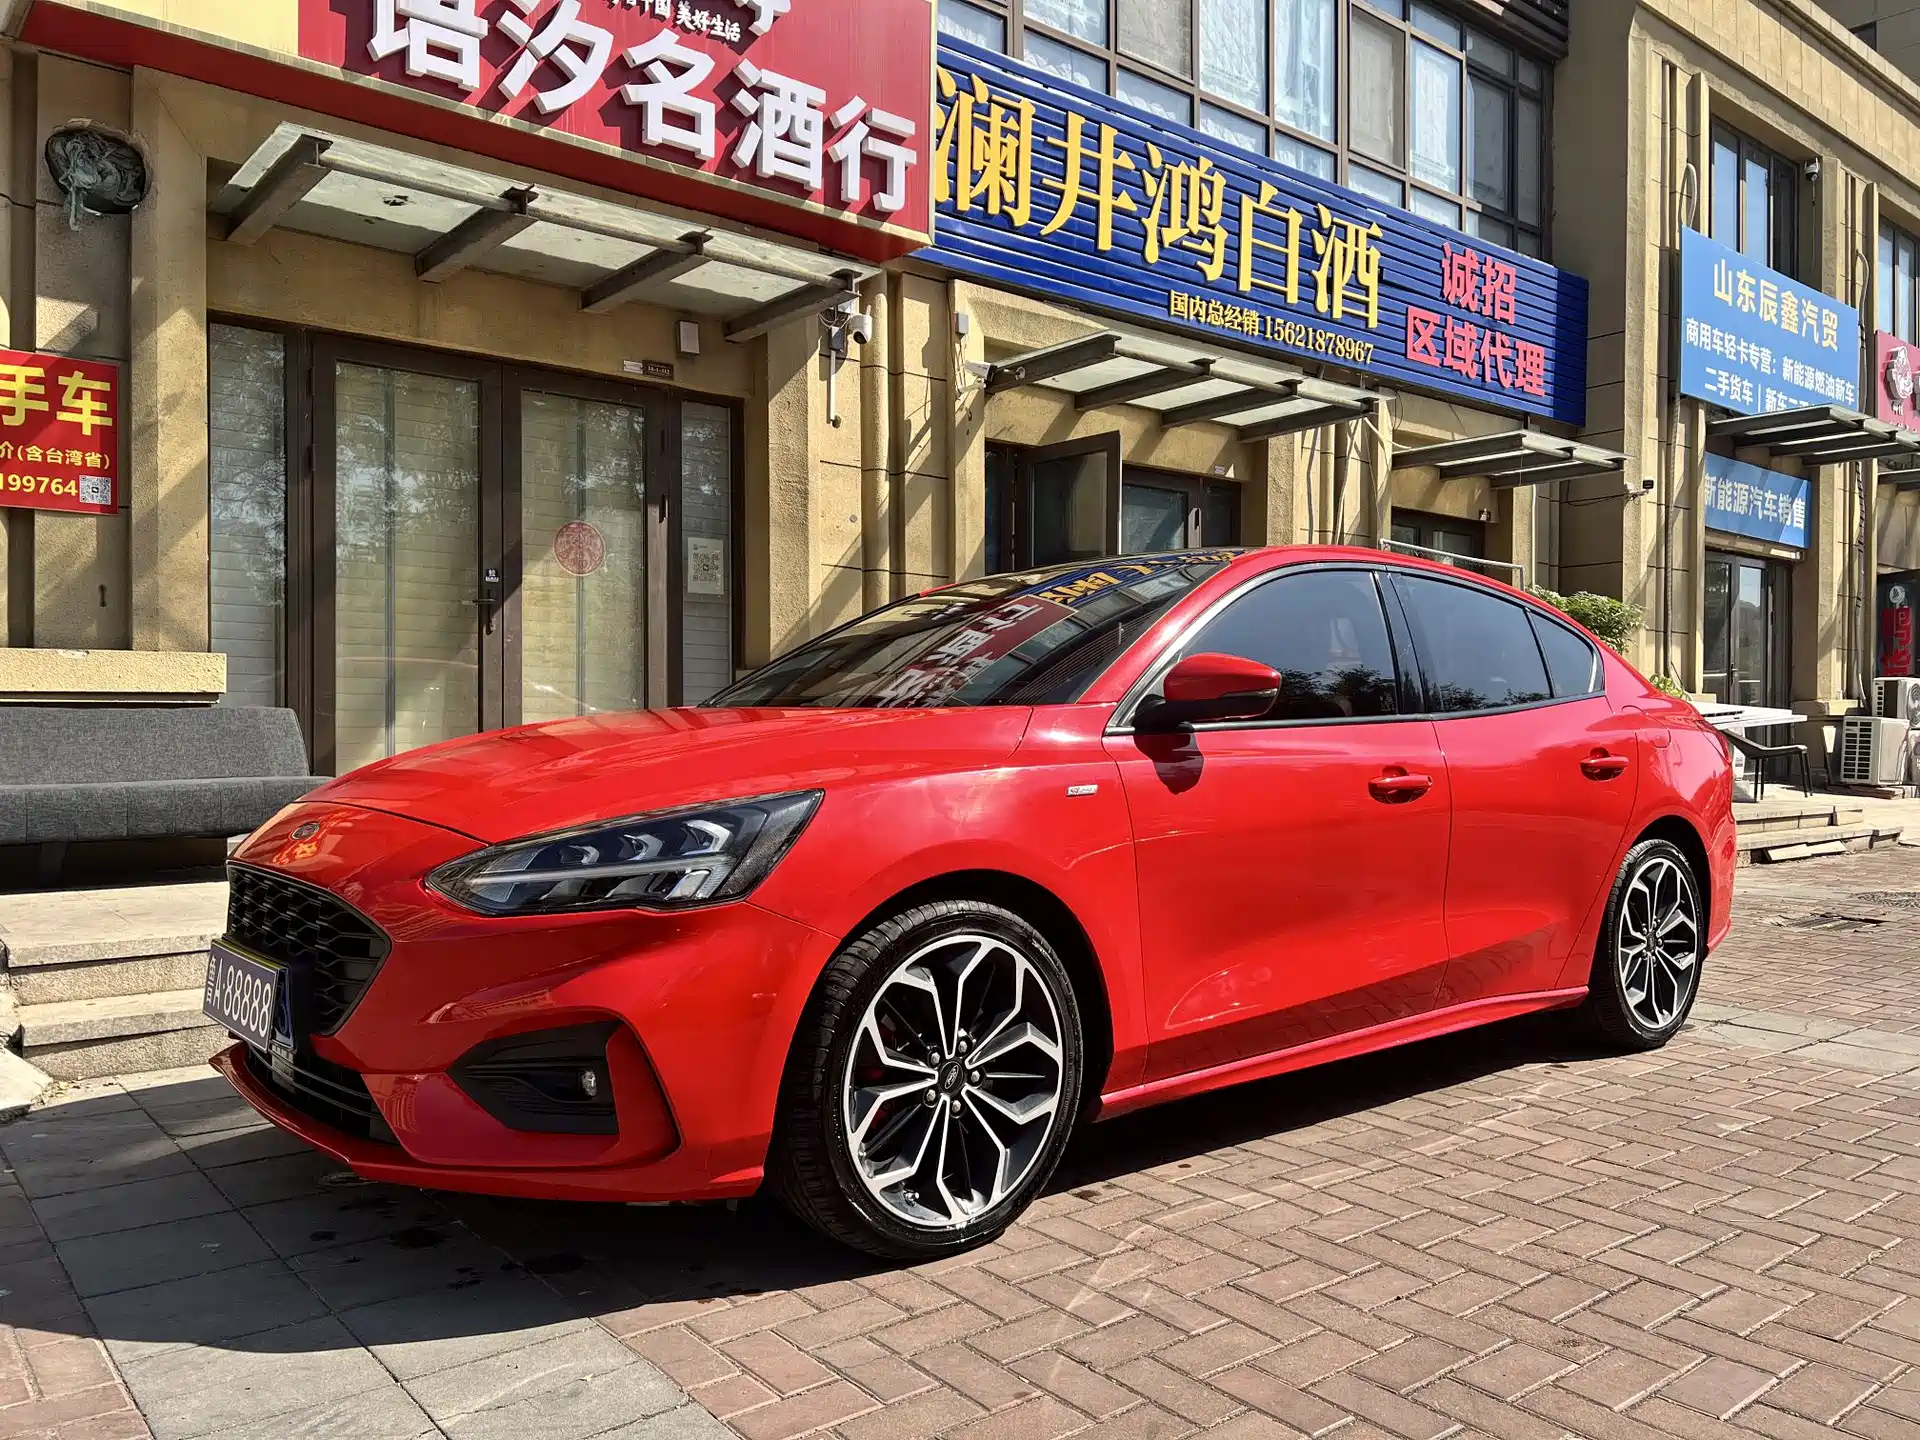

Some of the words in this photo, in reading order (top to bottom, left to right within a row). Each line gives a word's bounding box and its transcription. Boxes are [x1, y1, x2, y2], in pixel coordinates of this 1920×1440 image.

[675, 1, 741, 43] 美好生活
[935, 64, 1381, 329] 澜井鸿白酒
[1441, 242, 1517, 325] 诚招
[1713, 258, 1838, 352] 山东辰鑫汽贸
[1170, 289, 1259, 337] 国内总经销
[1264, 315, 1374, 364] 15621878967
[1406, 305, 1546, 397] 区域代理
[1703, 472, 1805, 529] 新能源汽车销售
